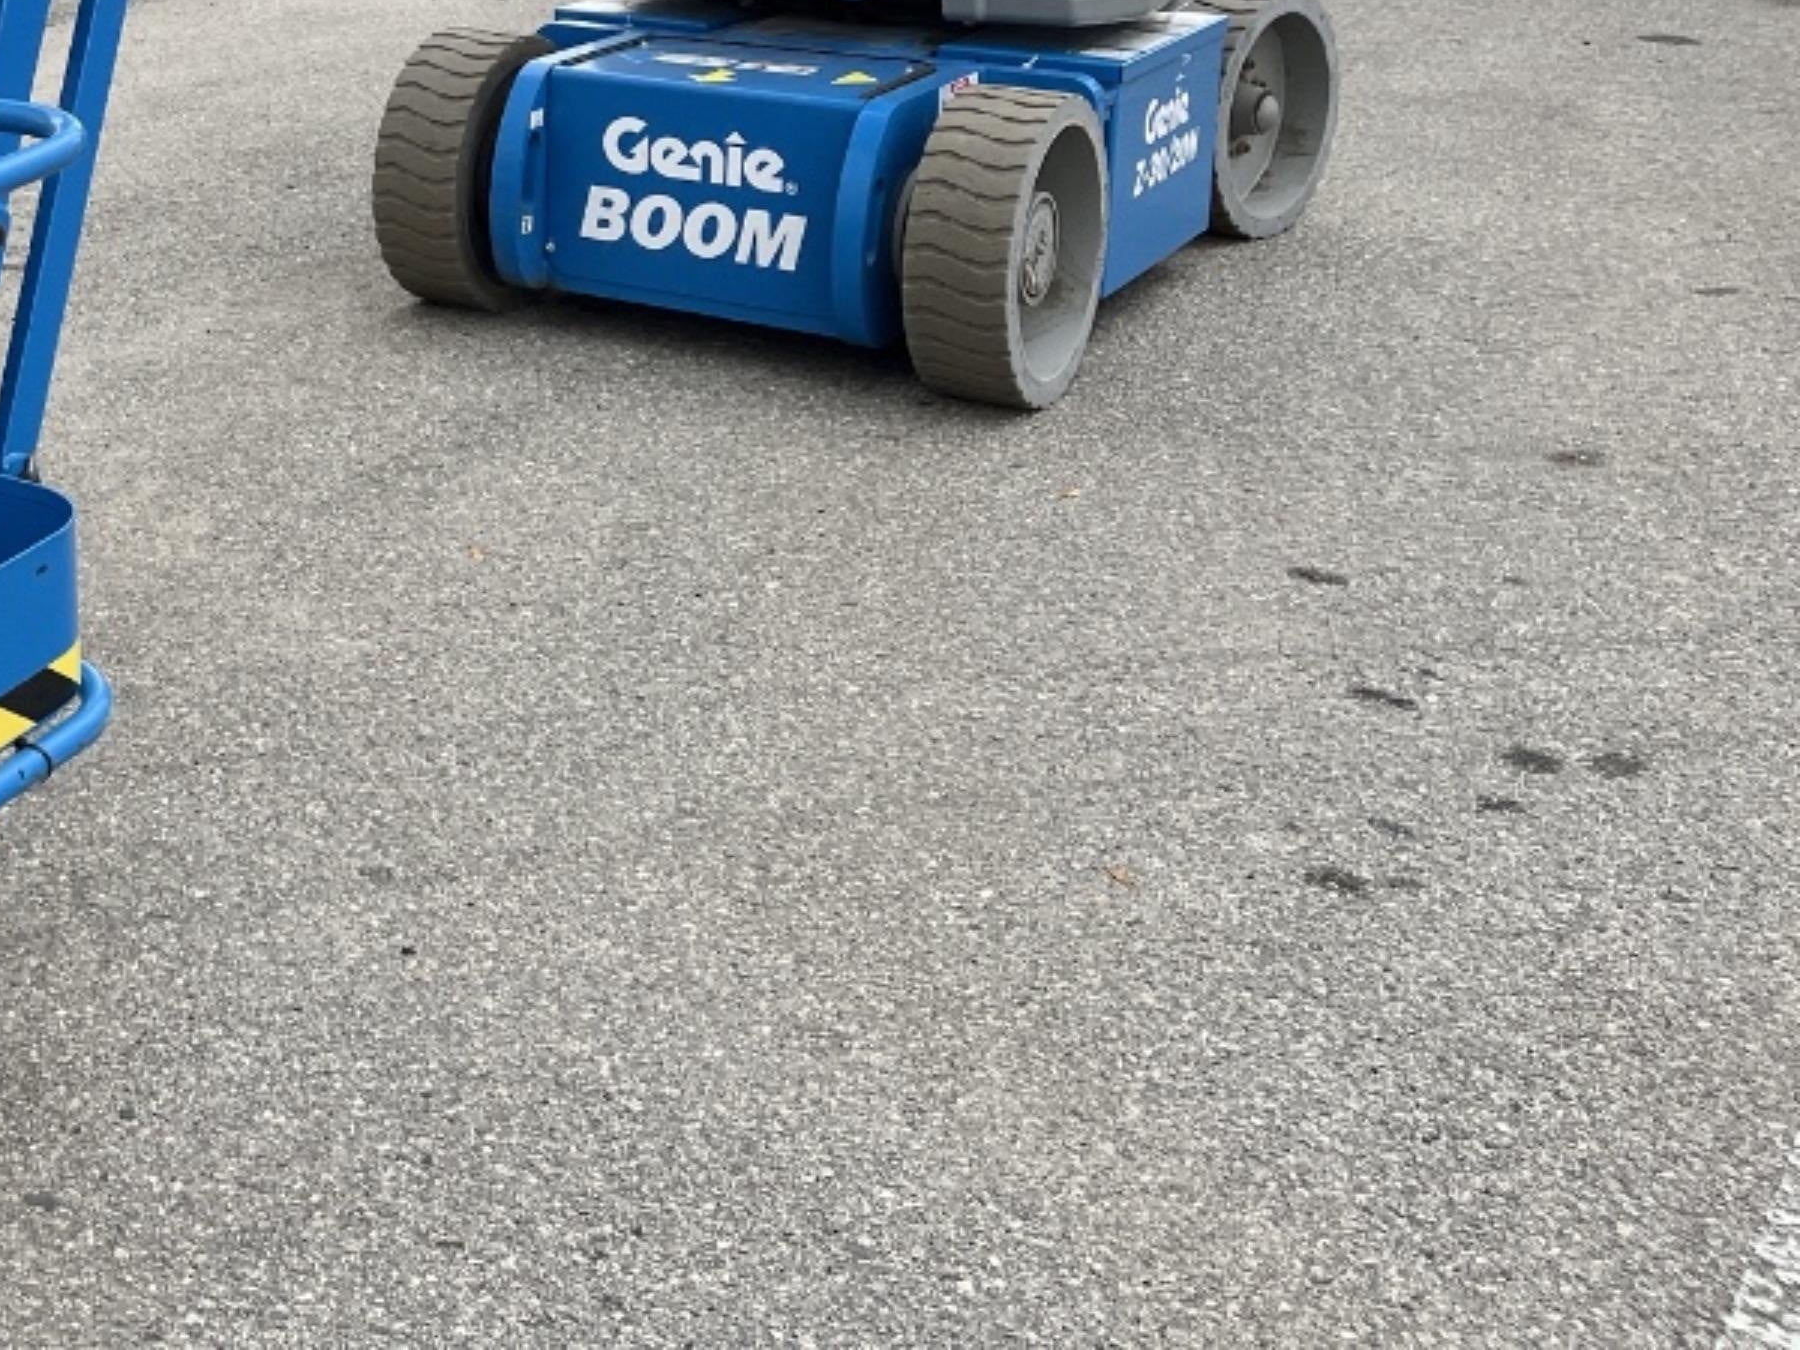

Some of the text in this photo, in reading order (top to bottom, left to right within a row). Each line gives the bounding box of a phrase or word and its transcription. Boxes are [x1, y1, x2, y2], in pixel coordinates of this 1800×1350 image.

[1144, 72, 1190, 145] Genie
[602, 115, 786, 194] Genie
[579, 184, 809, 272] BOOM
